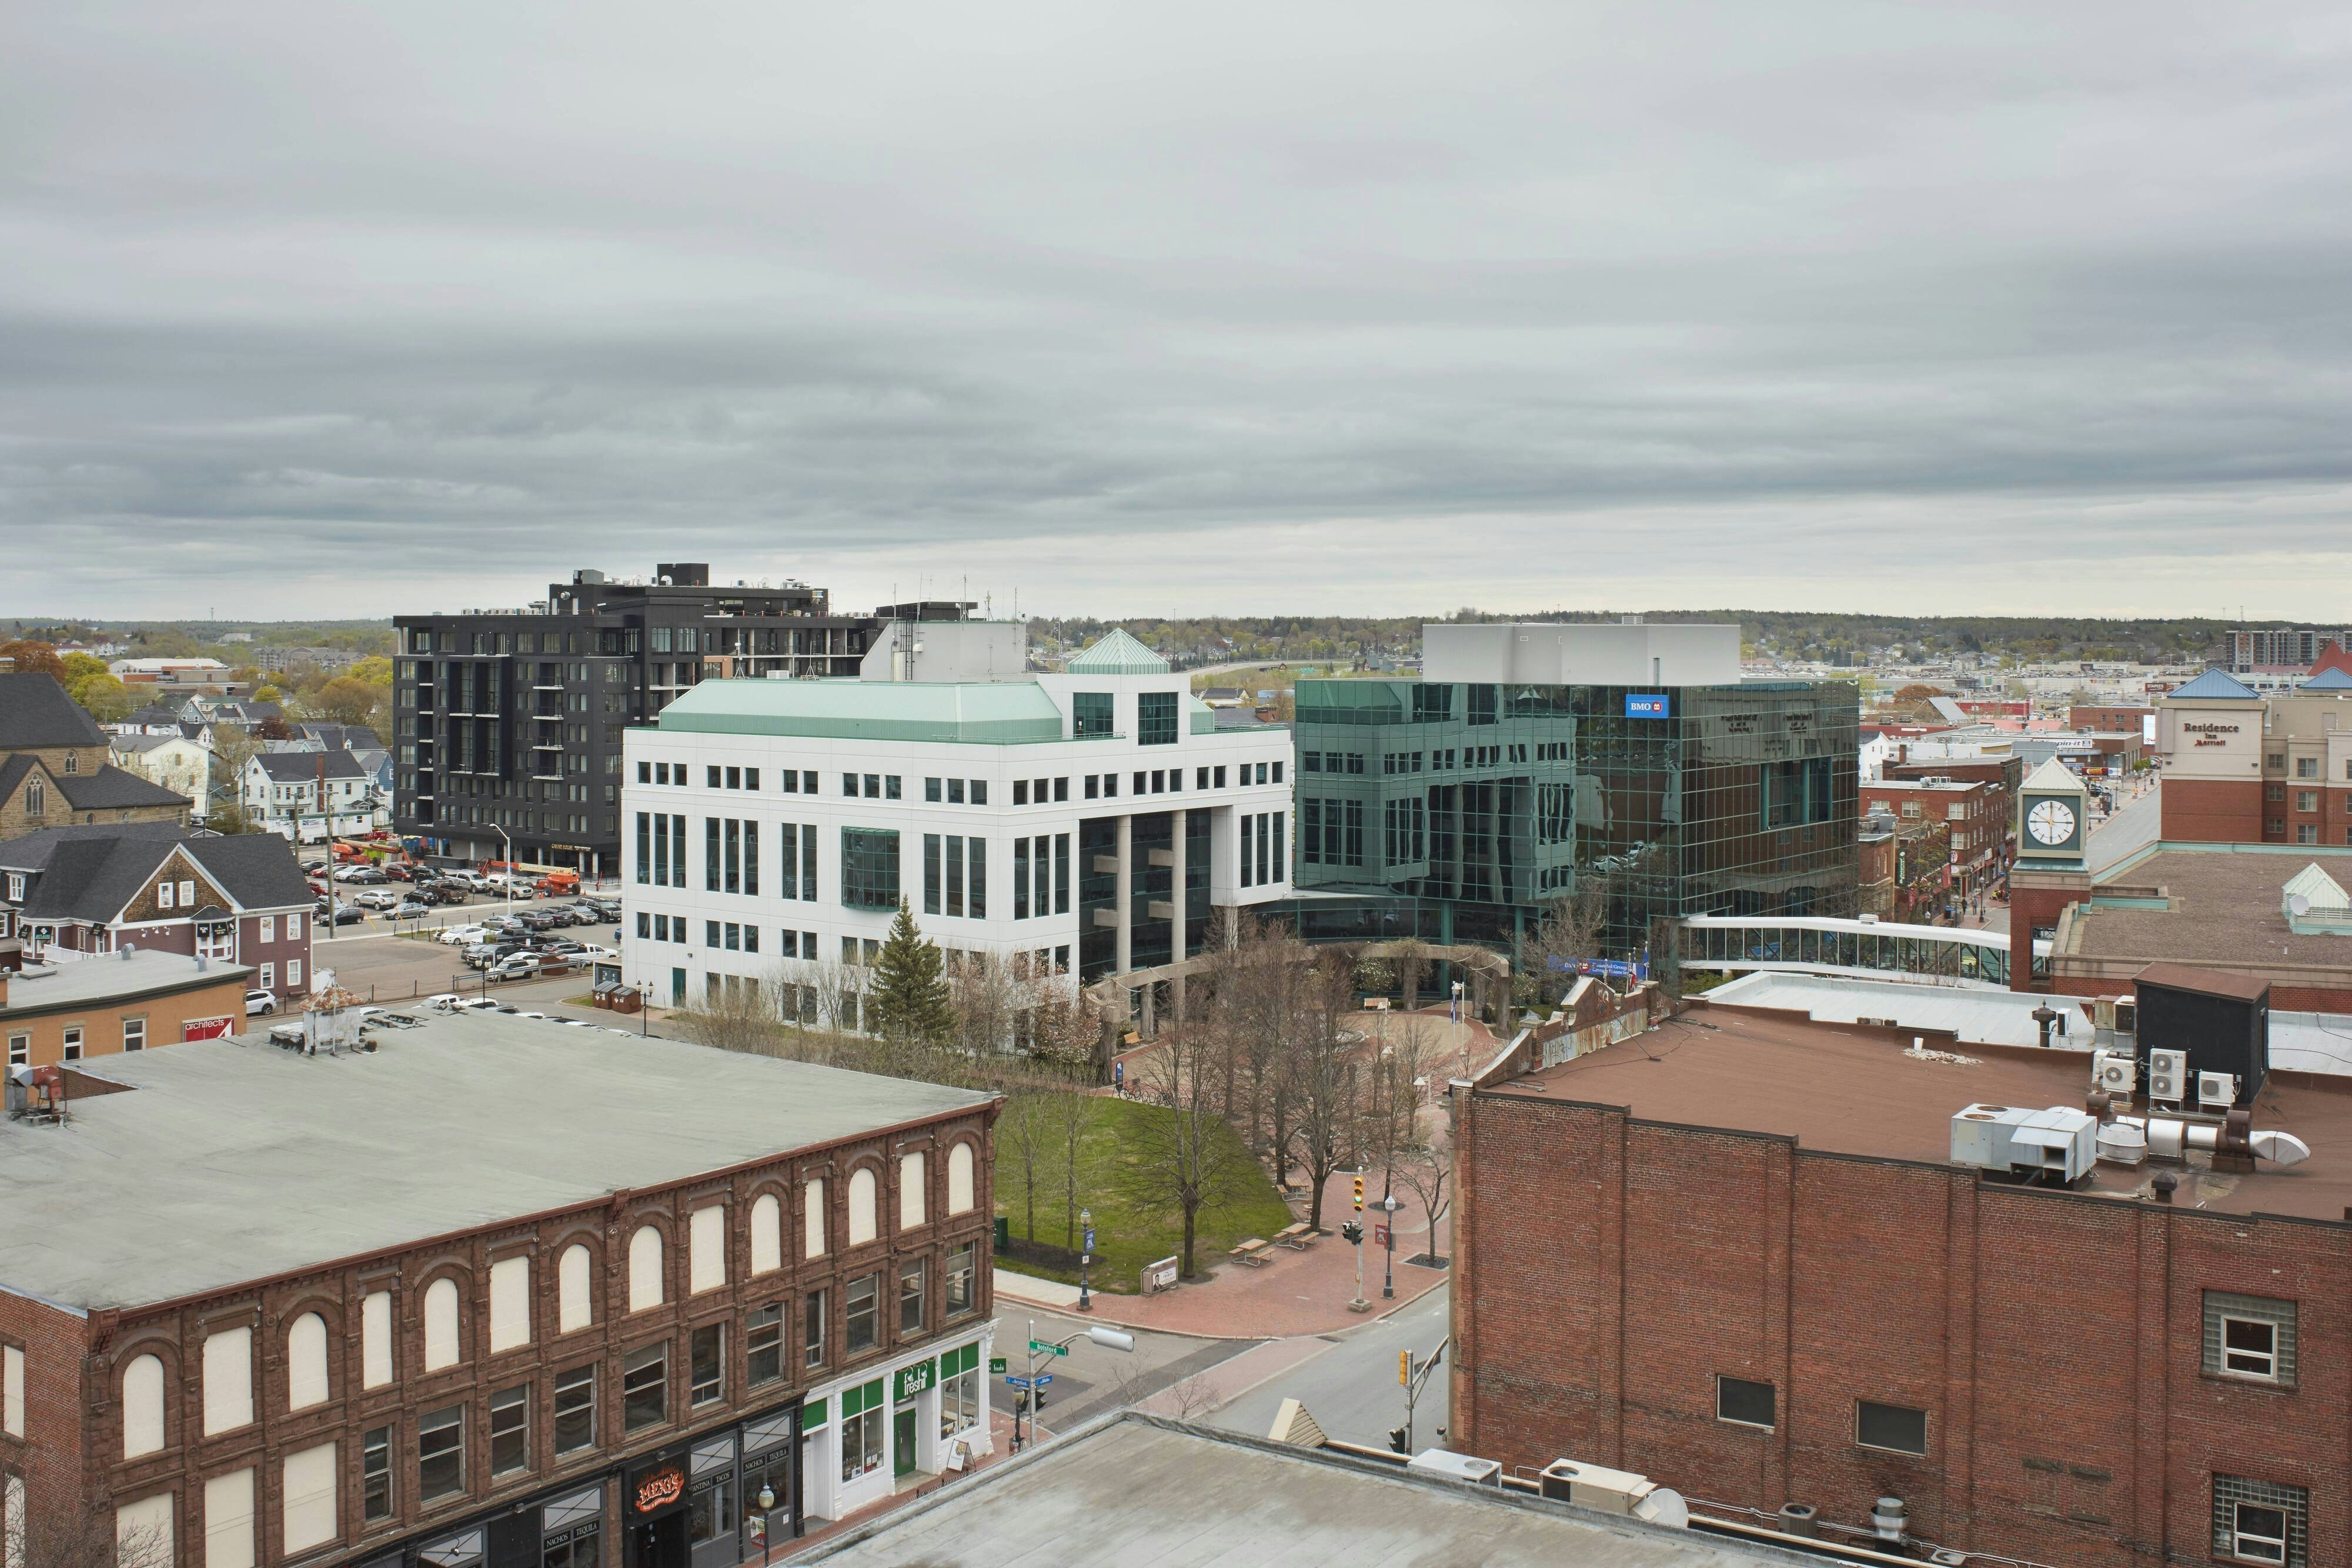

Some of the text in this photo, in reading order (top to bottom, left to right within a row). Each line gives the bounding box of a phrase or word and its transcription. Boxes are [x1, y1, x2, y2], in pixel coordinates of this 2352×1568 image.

[2184, 723, 2239, 733] Residence
[185, 1019, 225, 1030] architects
[1037, 1344, 1057, 1353] Botsford
[904, 1369, 926, 1396] freshii
[745, 1449, 787, 1470] NACHOS TEQUILA
[716, 1472, 730, 1482] TACOS
[547, 1523, 597, 1547] NACHOS TEQUILA
